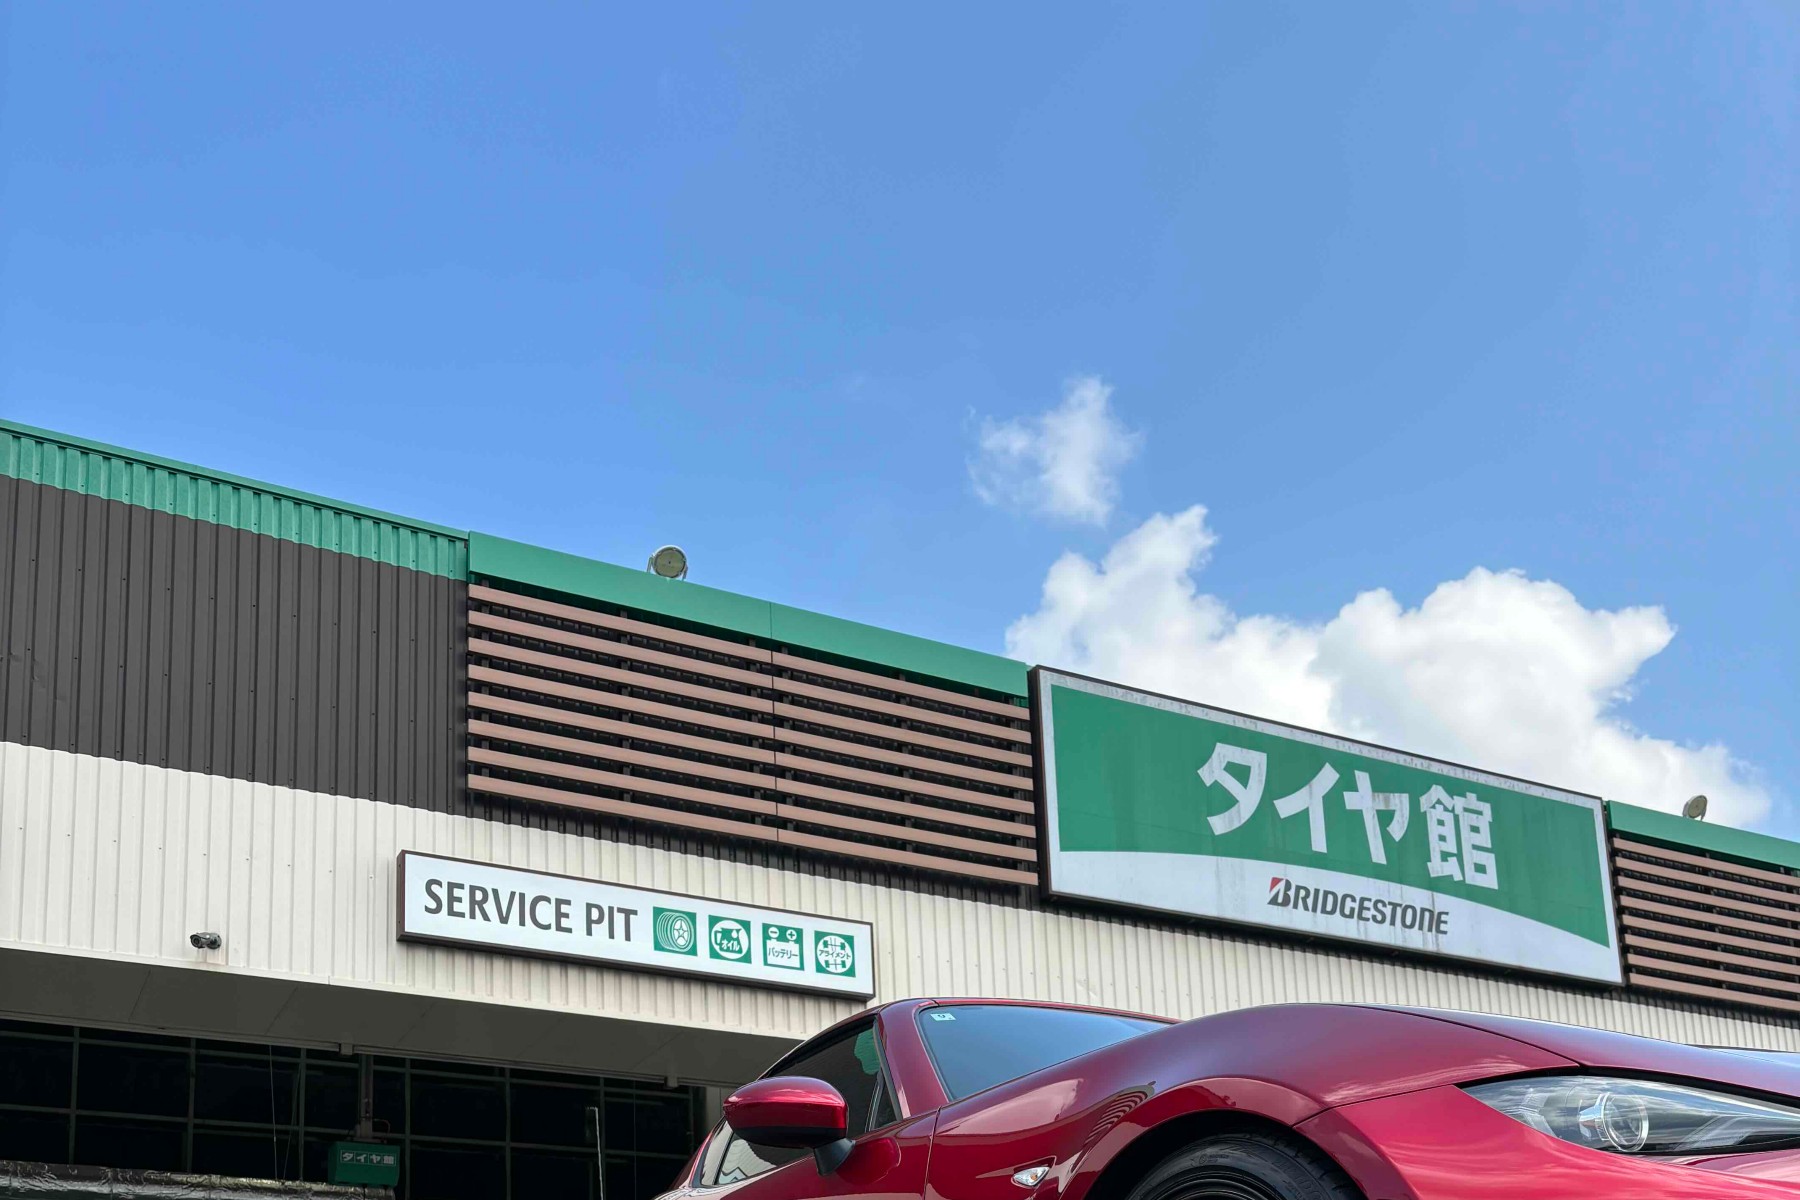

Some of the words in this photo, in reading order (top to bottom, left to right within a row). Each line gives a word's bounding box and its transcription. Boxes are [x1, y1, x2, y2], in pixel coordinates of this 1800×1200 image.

[1197, 742, 1499, 890] タイヤ館
[424, 878, 573, 934] SERVICE
[585, 902, 639, 942] PIT
[1267, 876, 1450, 936] BRIDGESTONE
[721, 939, 741, 952] オイル
[768, 947, 799, 960] バッテリー
[818, 949, 851, 960] アライメント
